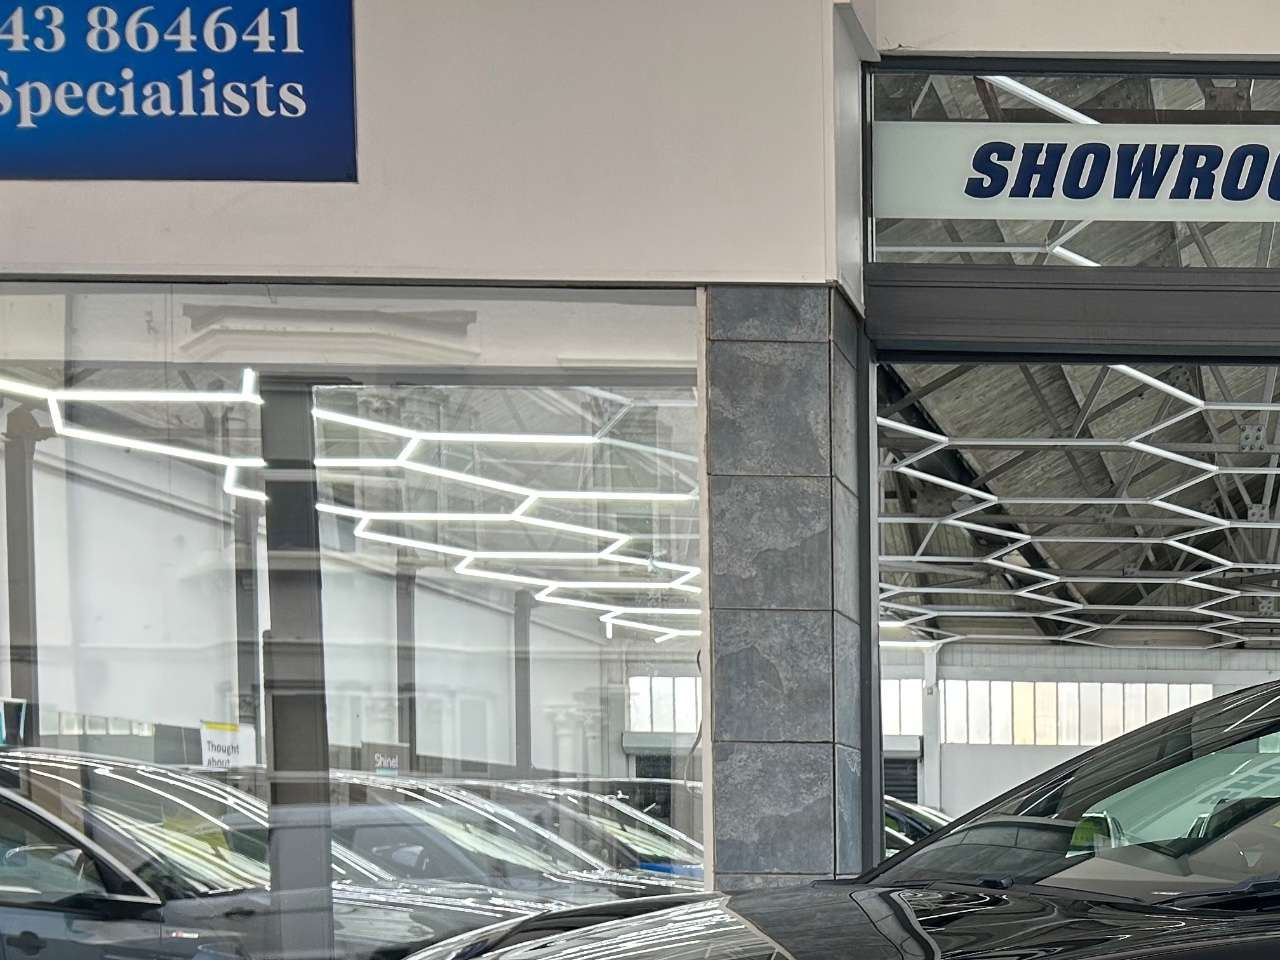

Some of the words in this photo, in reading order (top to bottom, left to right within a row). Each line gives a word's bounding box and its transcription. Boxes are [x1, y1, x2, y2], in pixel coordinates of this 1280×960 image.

[0, 5, 66, 52] 43
[86, 5, 304, 53] 864641
[206, 740, 240, 756] Thought
